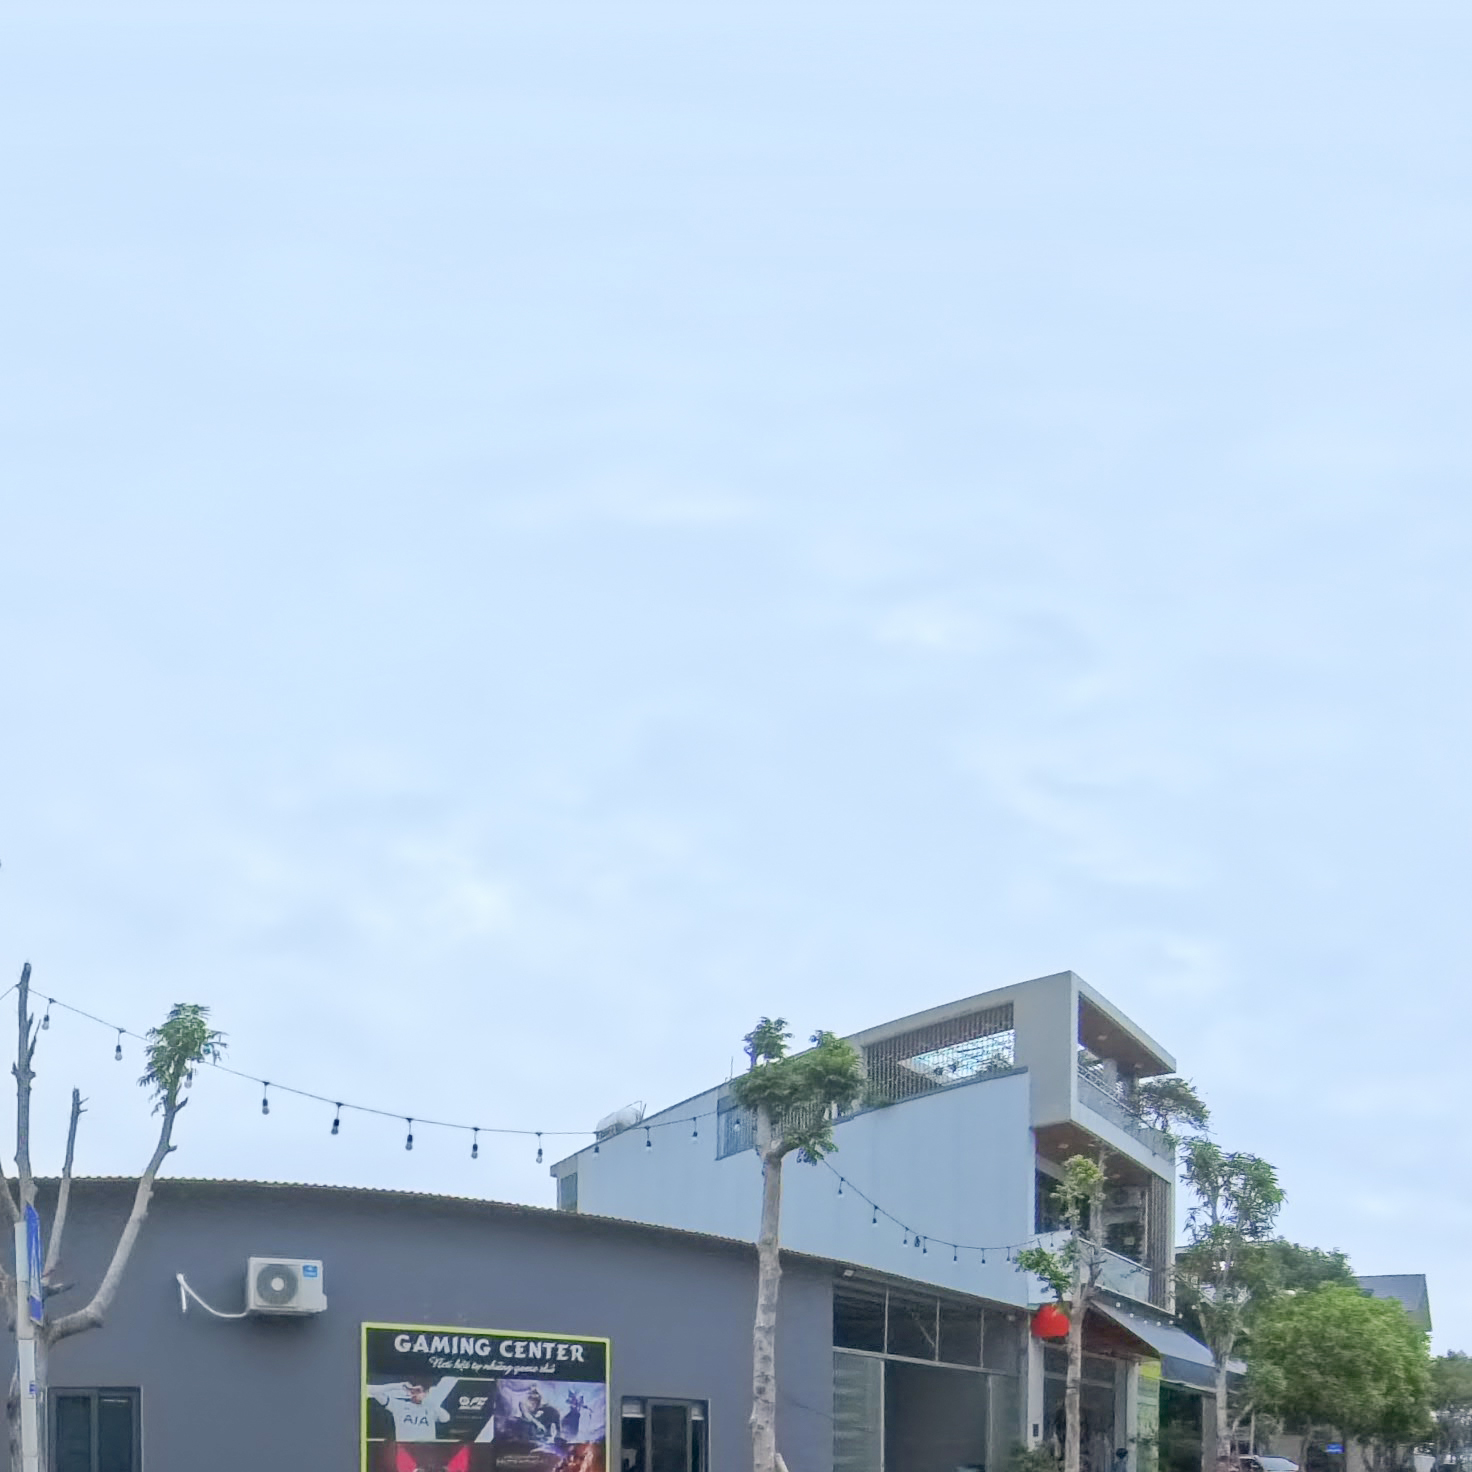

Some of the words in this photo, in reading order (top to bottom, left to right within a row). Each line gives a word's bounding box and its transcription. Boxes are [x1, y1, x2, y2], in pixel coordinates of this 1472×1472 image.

[394, 1334, 491, 1356] GAMING
[499, 1340, 584, 1362] CENTER
[403, 1414, 430, 1427] AIA
